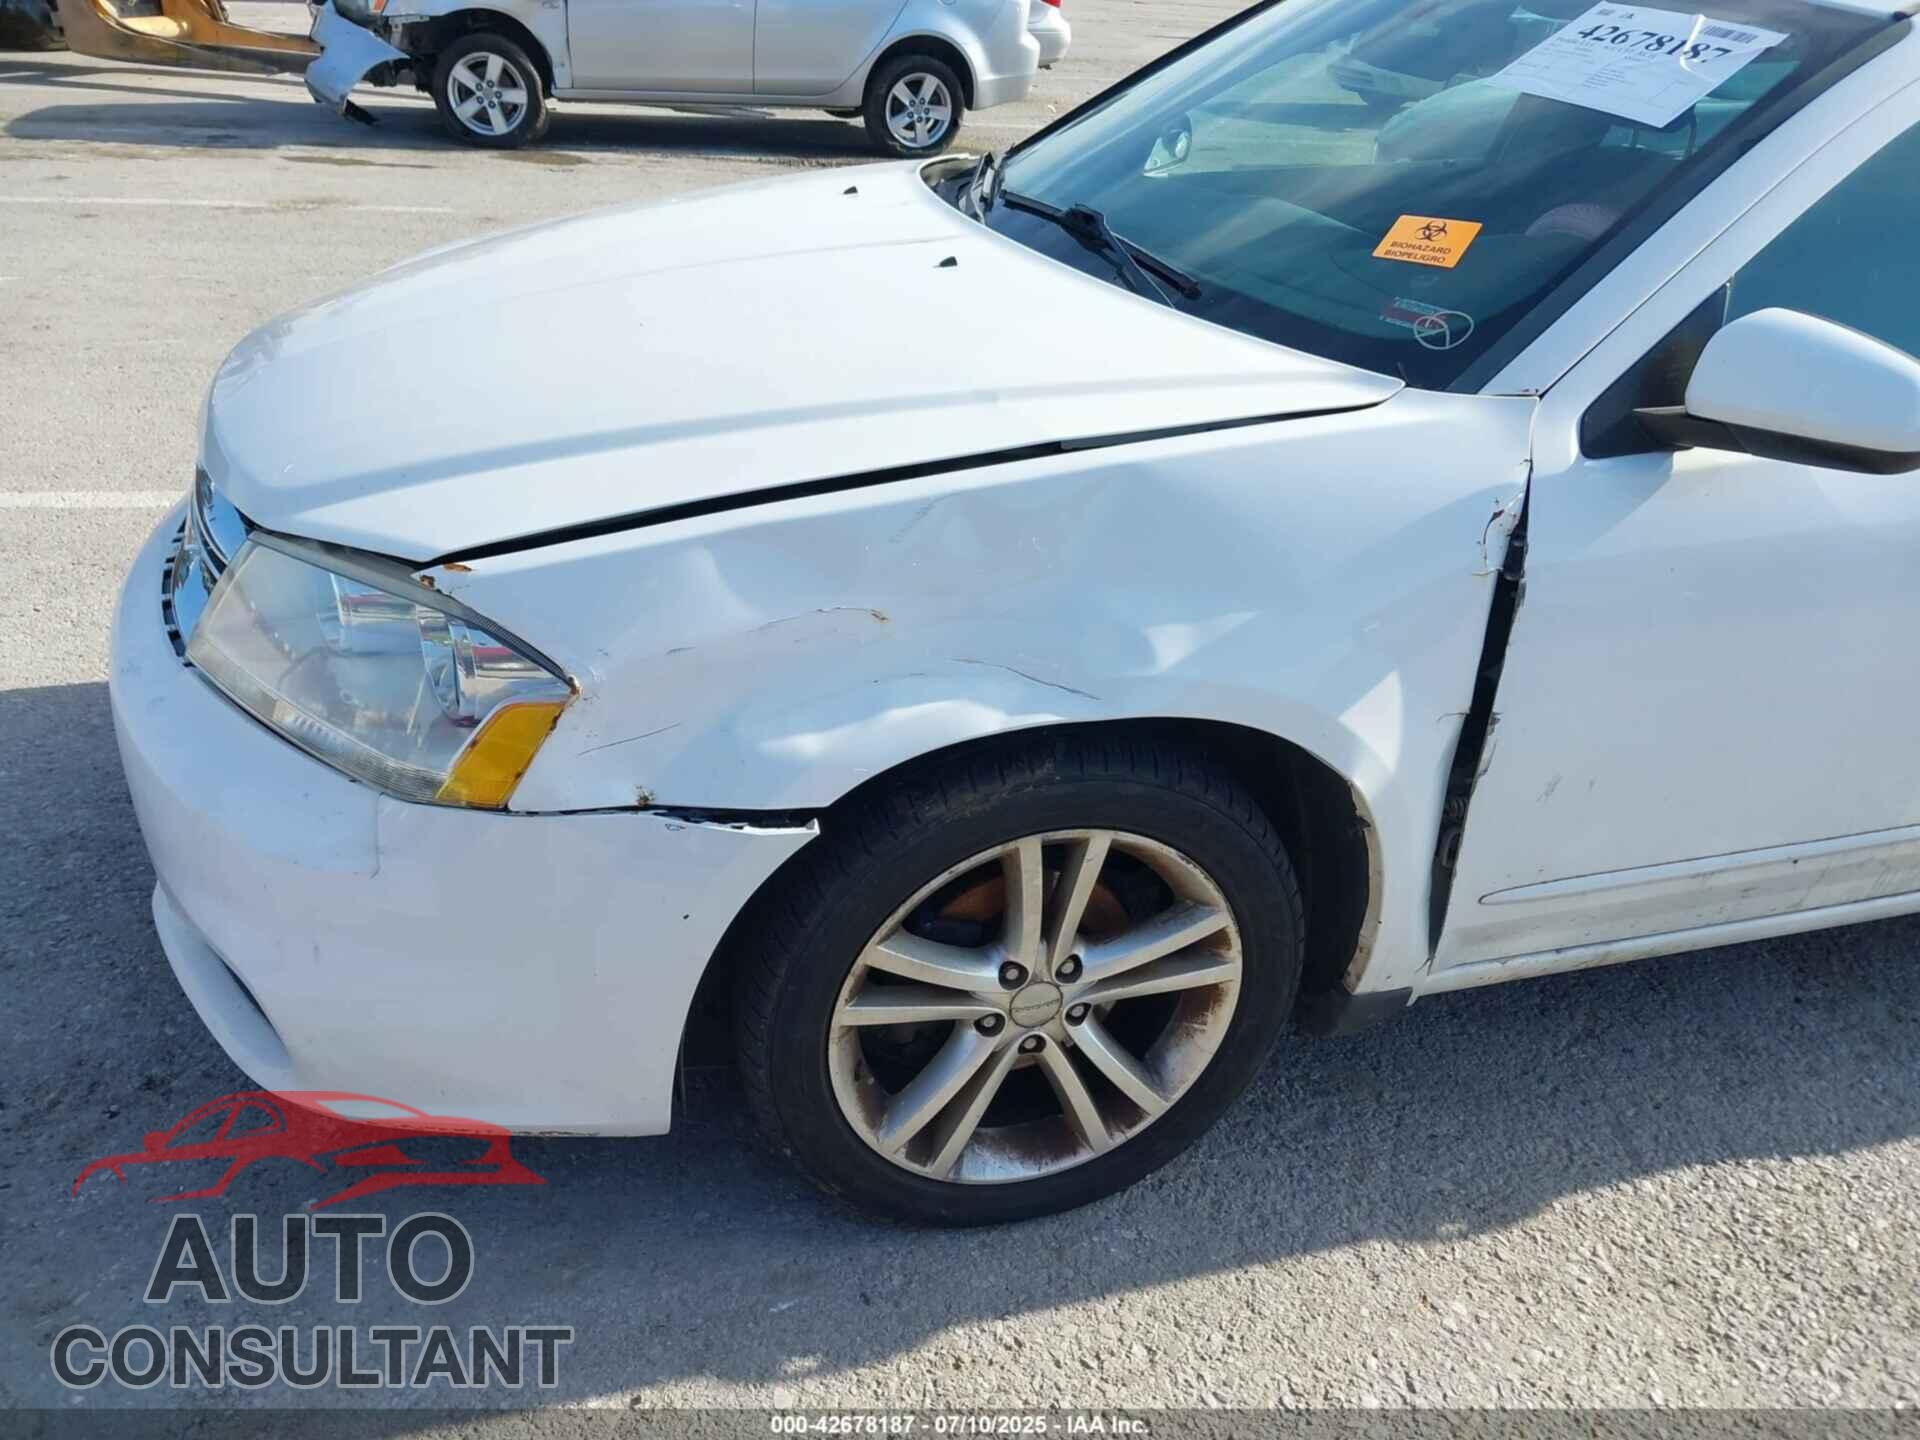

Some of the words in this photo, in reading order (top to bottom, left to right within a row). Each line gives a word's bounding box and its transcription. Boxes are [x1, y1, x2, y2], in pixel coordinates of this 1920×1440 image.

[1577, 23, 1733, 63] 42678187
[1390, 240, 1452, 255] BIOHAZARD
[1384, 249, 1446, 264] BIOPELIGRO
